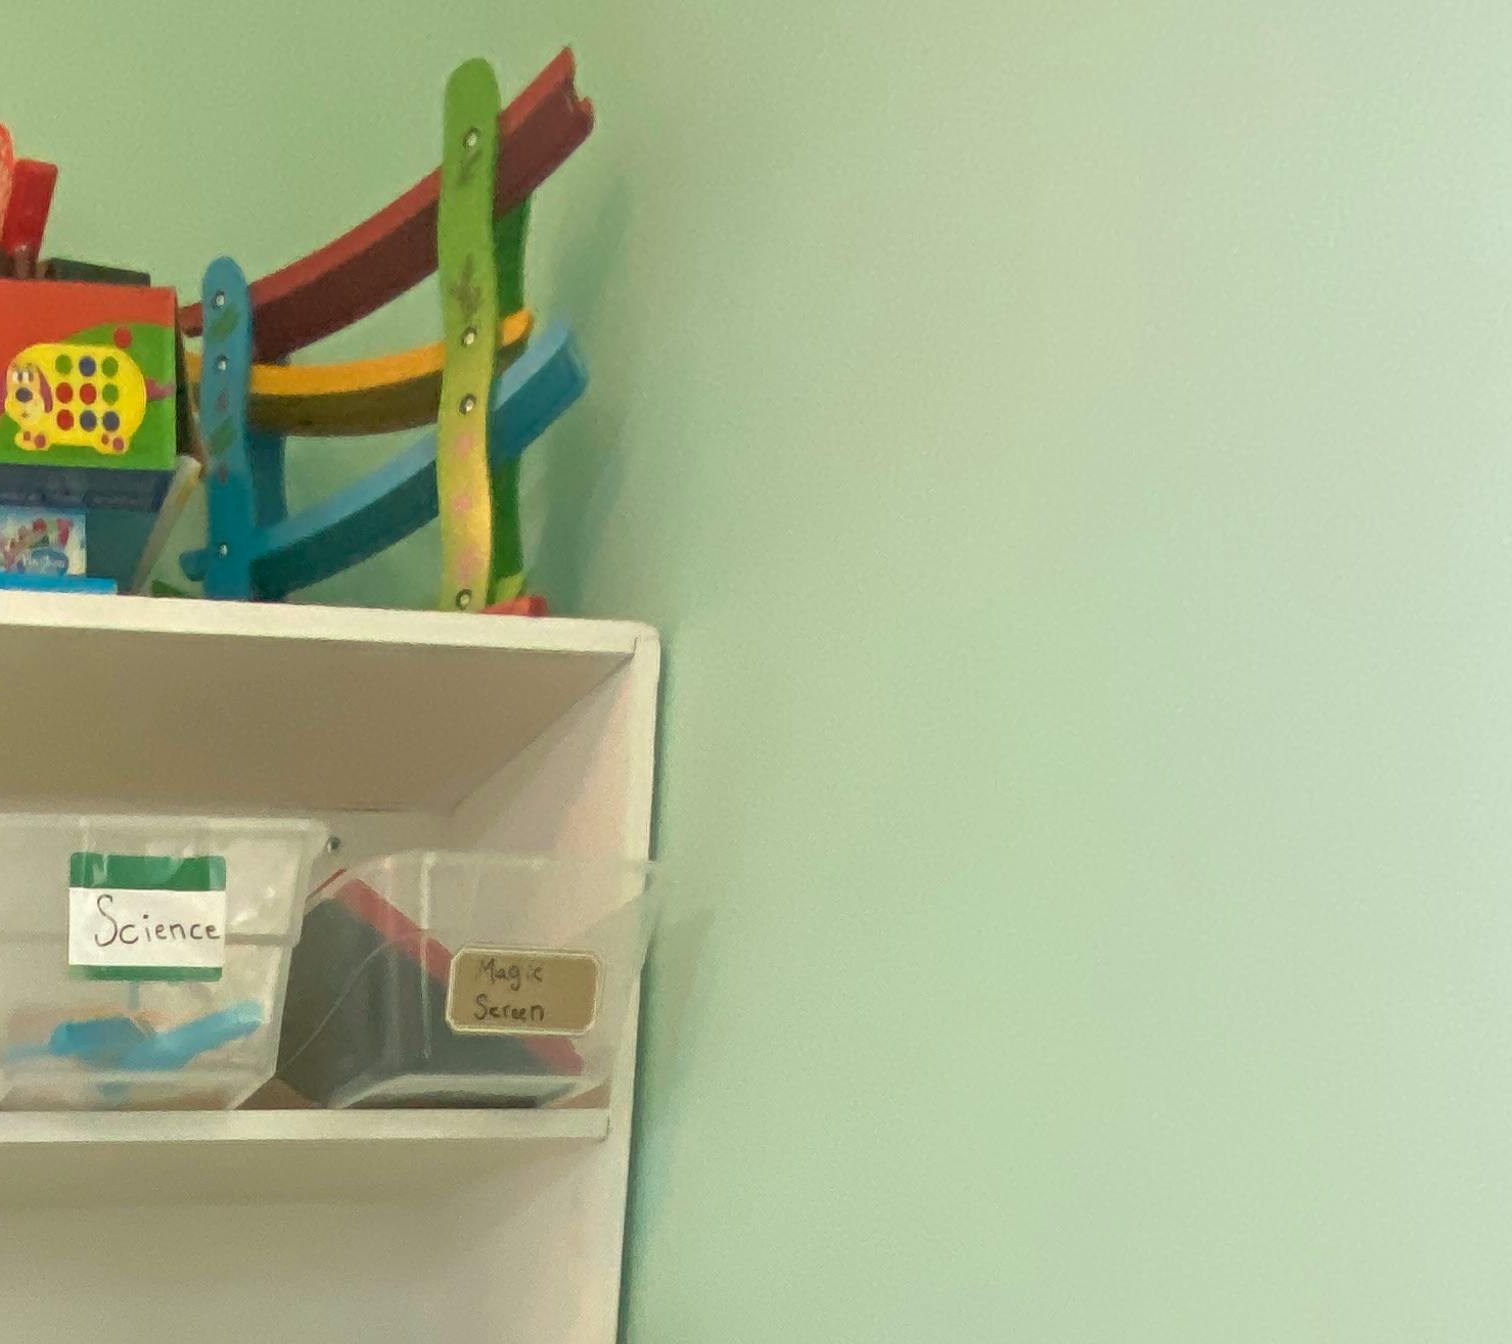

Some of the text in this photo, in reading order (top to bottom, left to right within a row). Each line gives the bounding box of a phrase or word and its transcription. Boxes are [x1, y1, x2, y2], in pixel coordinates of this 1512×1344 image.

[94, 893, 221, 948] Science
[479, 957, 543, 991] Magic
[473, 993, 545, 1022] Screen
